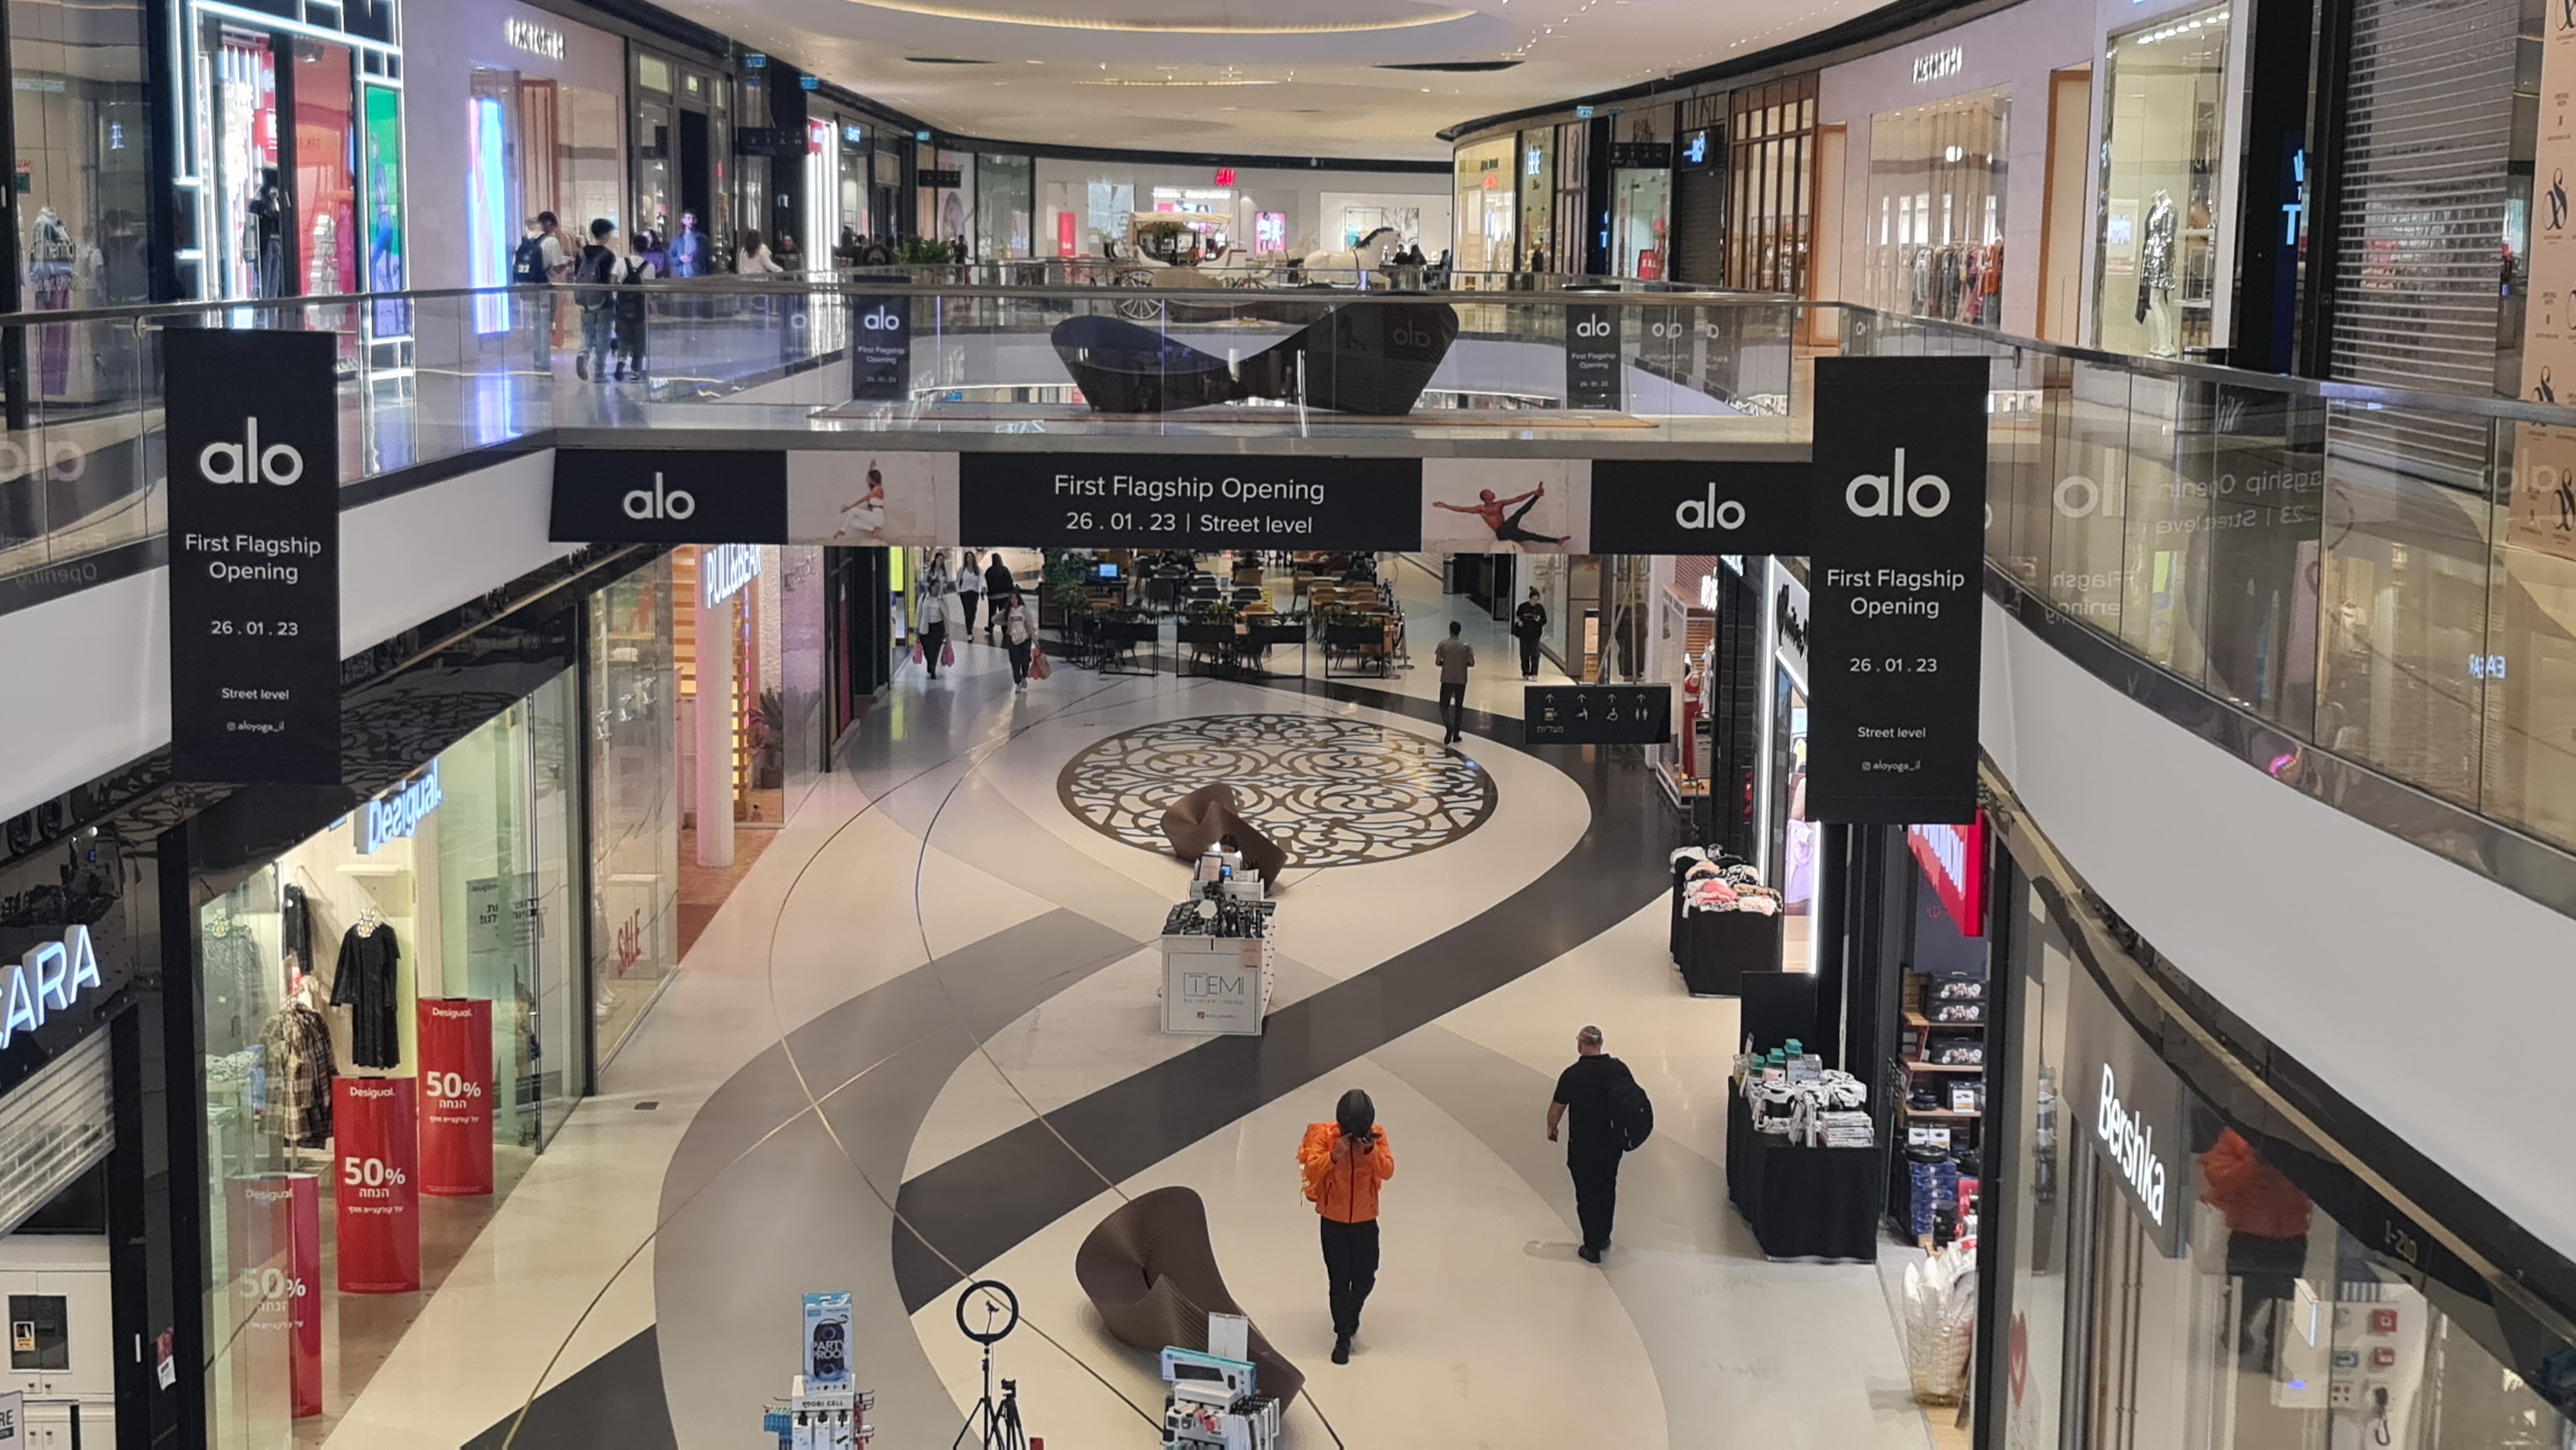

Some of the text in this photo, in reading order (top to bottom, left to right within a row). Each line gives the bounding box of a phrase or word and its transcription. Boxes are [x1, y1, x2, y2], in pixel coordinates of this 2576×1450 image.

[864, 305, 900, 330] alo
[1577, 314, 1610, 337] alo
[866, 356, 897, 365] Opening
[1579, 362, 1609, 370] Opening
[200, 417, 303, 484] alo
[1055, 475, 1325, 505] First Flagship Opening
[1846, 447, 1950, 518] alo
[623, 471, 695, 520] alo
[1676, 482, 1746, 530] alo
[1200, 515, 1260, 532] Street
[1266, 516, 1312, 534] level
[185, 534, 321, 558] First Flagship
[209, 561, 298, 584] Opening
[1827, 569, 1965, 591] First Flagship
[1851, 597, 1939, 619] Opening
[222, 688, 289, 700] Street level
[1858, 727, 1926, 738] Street level
[618, 907, 642, 979] SALE
[0, 925, 100, 1050] ARA
[1188, 975, 1244, 995] TEMI
[426, 1071, 481, 1098] 50%
[439, 1100, 467, 1109] הנחה
[2098, 1062, 2165, 1227] Bershka
[345, 1157, 406, 1186] 50%
[359, 1188, 390, 1198] הנחה
